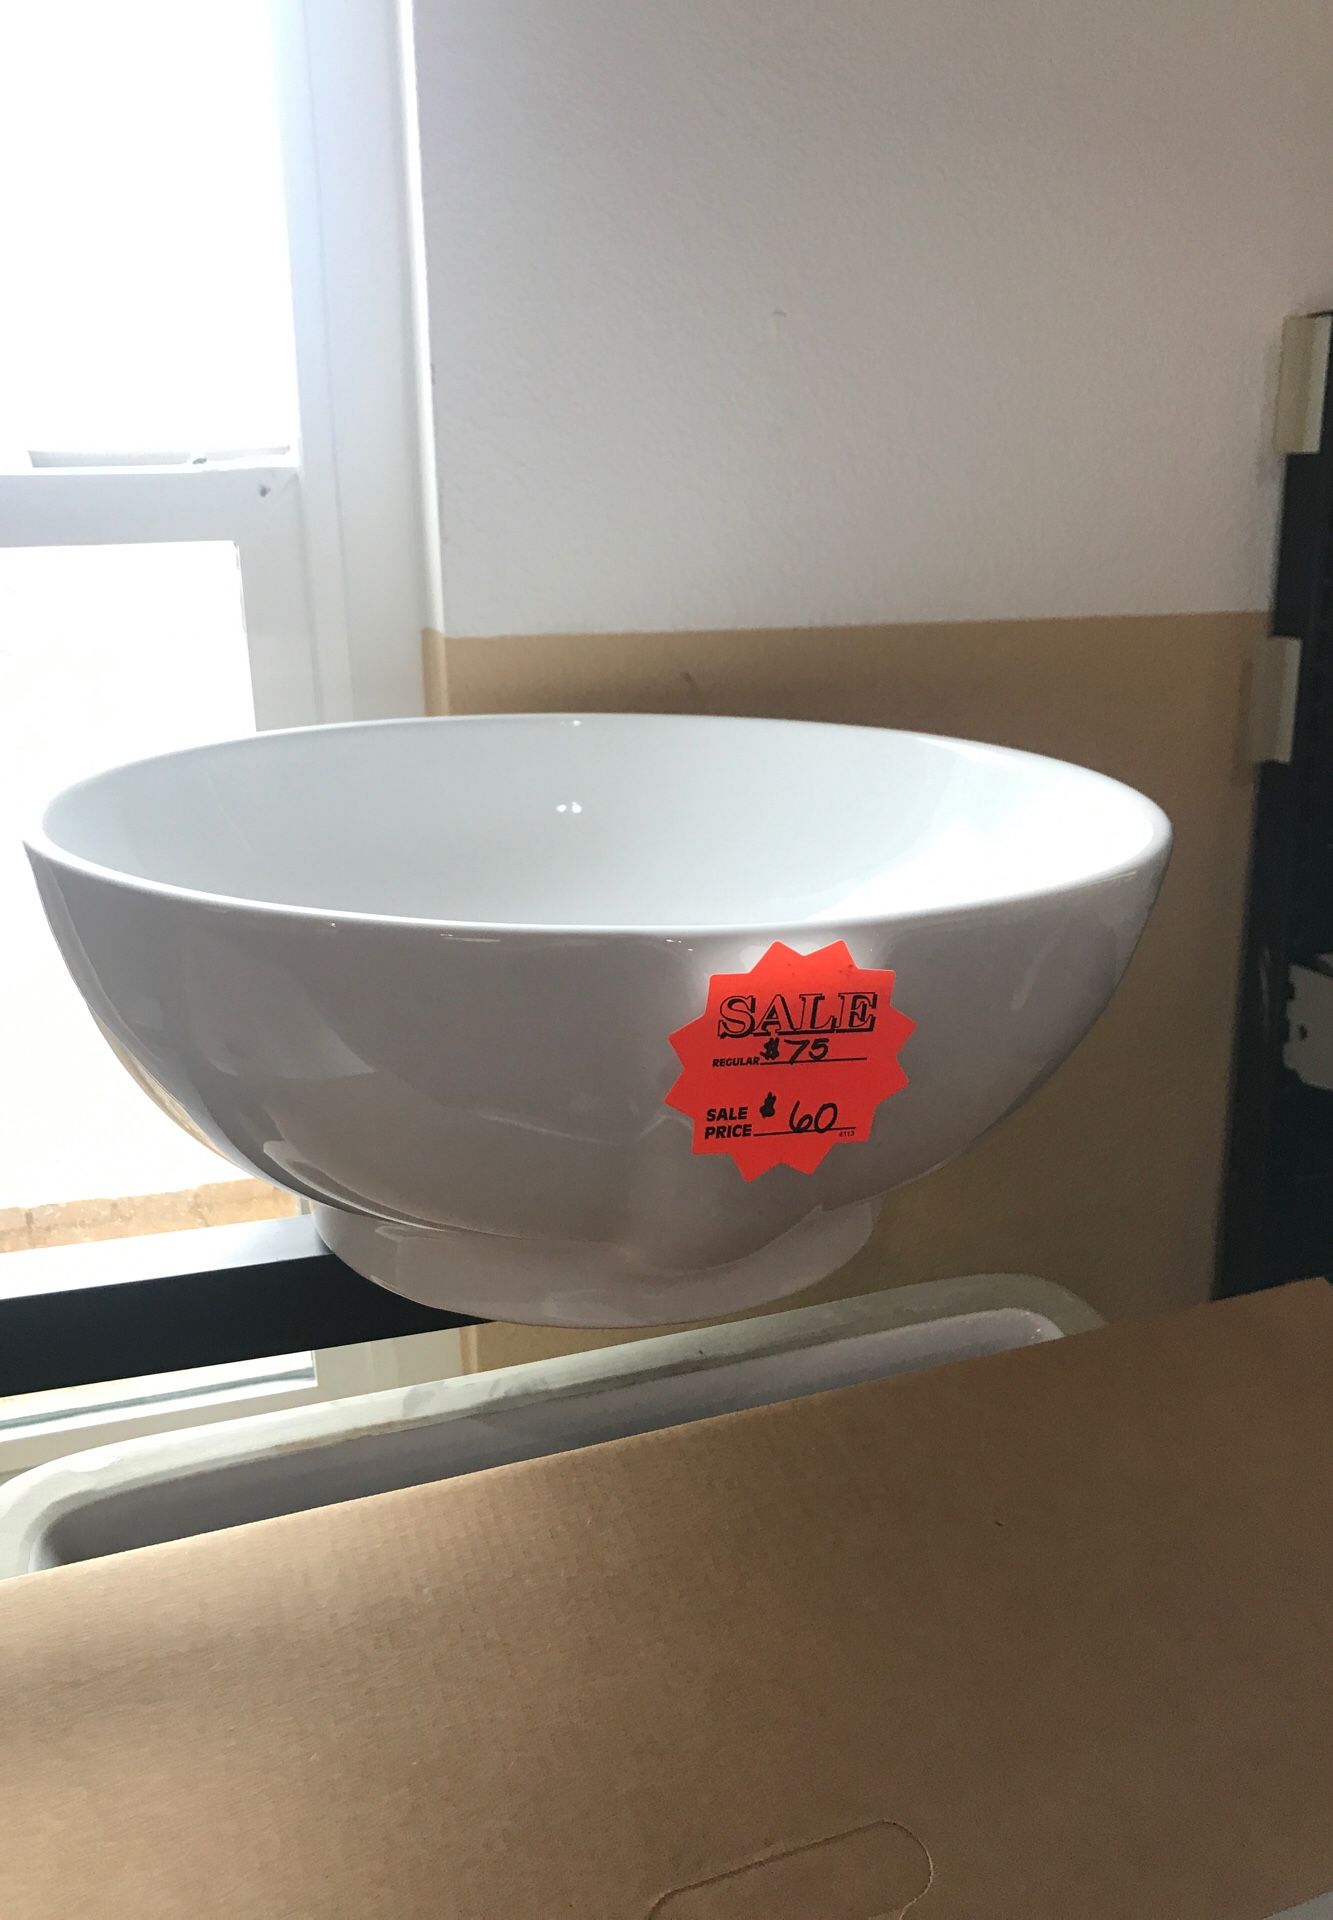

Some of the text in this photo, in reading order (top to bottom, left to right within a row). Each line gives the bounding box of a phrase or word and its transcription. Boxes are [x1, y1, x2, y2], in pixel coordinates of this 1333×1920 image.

[718, 992, 878, 1039] SALE
[712, 1056, 760, 1067] REGULAR
[706, 1107, 748, 1122] SALE
[705, 1124, 752, 1139] PRICE
